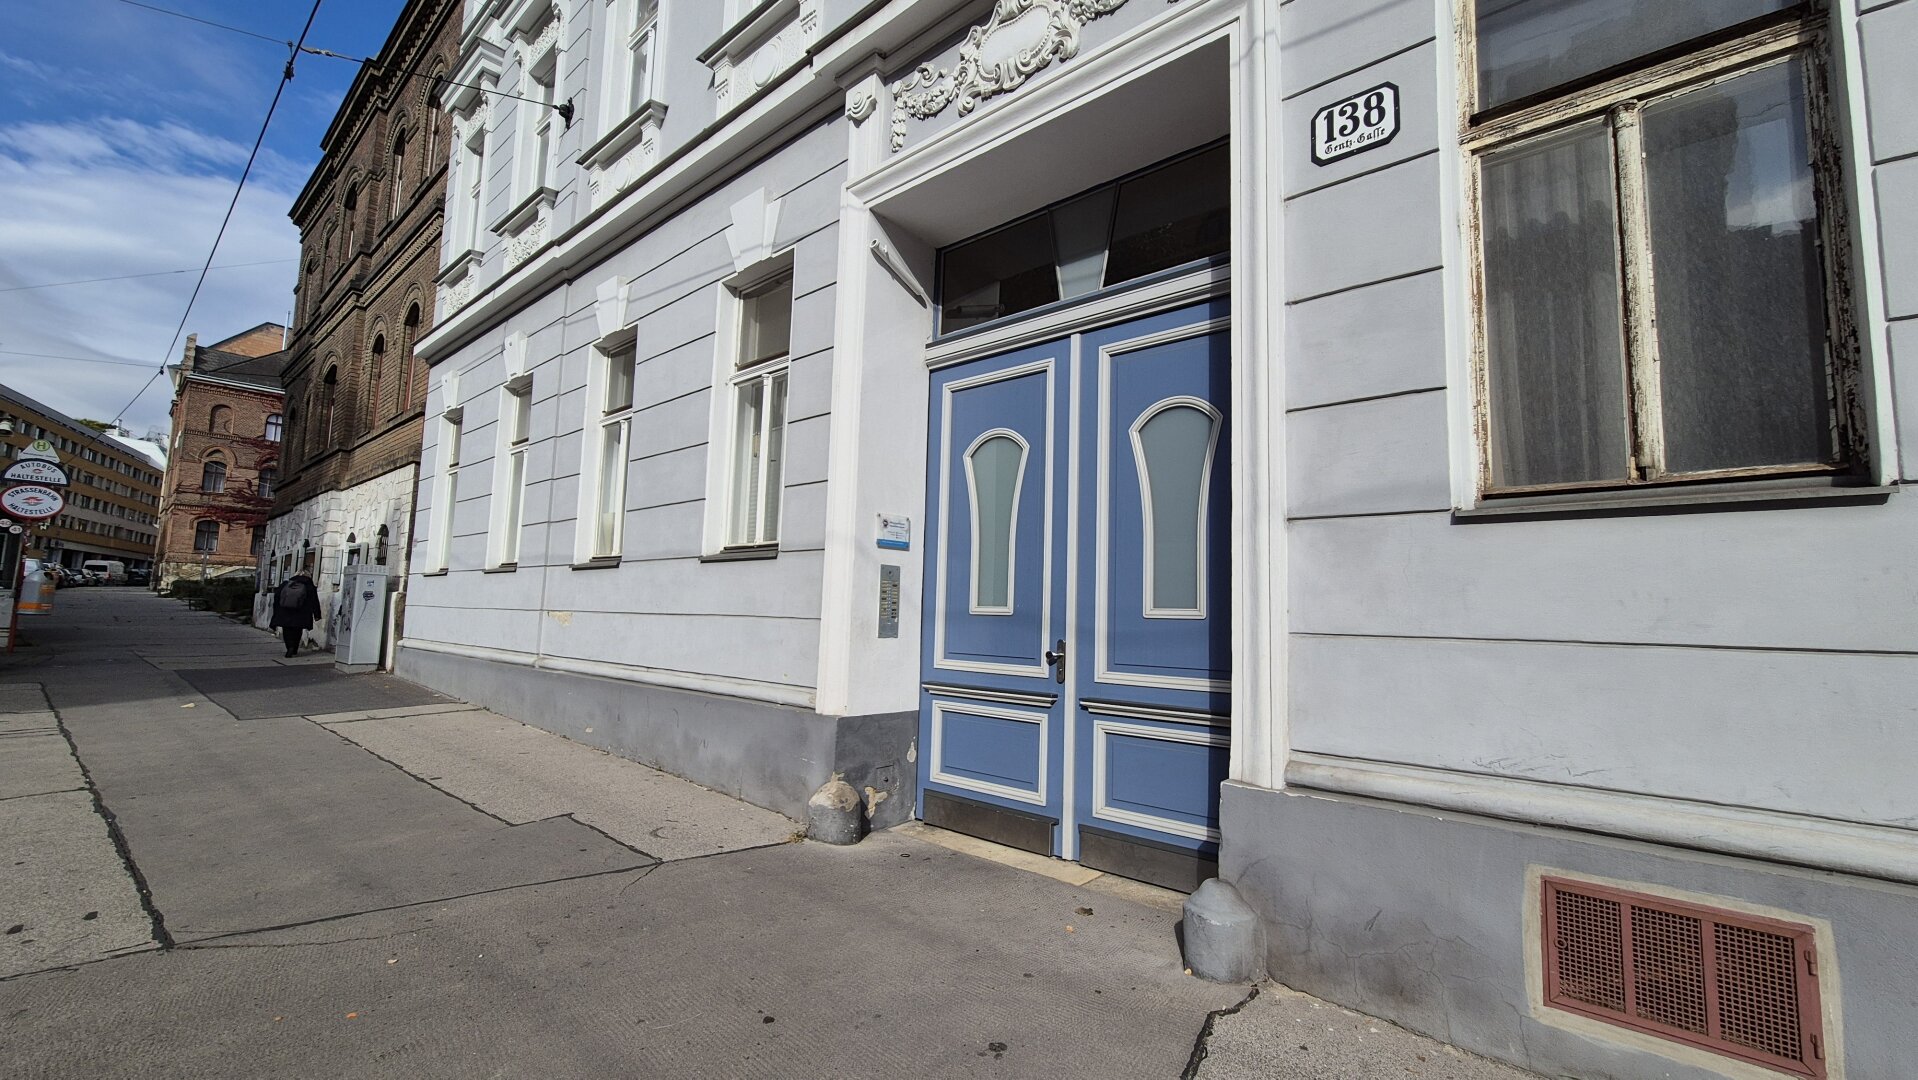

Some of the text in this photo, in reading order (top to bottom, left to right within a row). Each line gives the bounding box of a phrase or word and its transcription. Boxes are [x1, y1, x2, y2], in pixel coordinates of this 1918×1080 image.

[1323, 91, 1386, 145] 138
[36, 441, 46, 449] H
[20, 462, 58, 474] AUTOBUS
[10, 472, 62, 483] HALTESTELLE
[7, 487, 59, 502] STRASSENBAHN
[8, 502, 55, 515] HALTESTELLE
